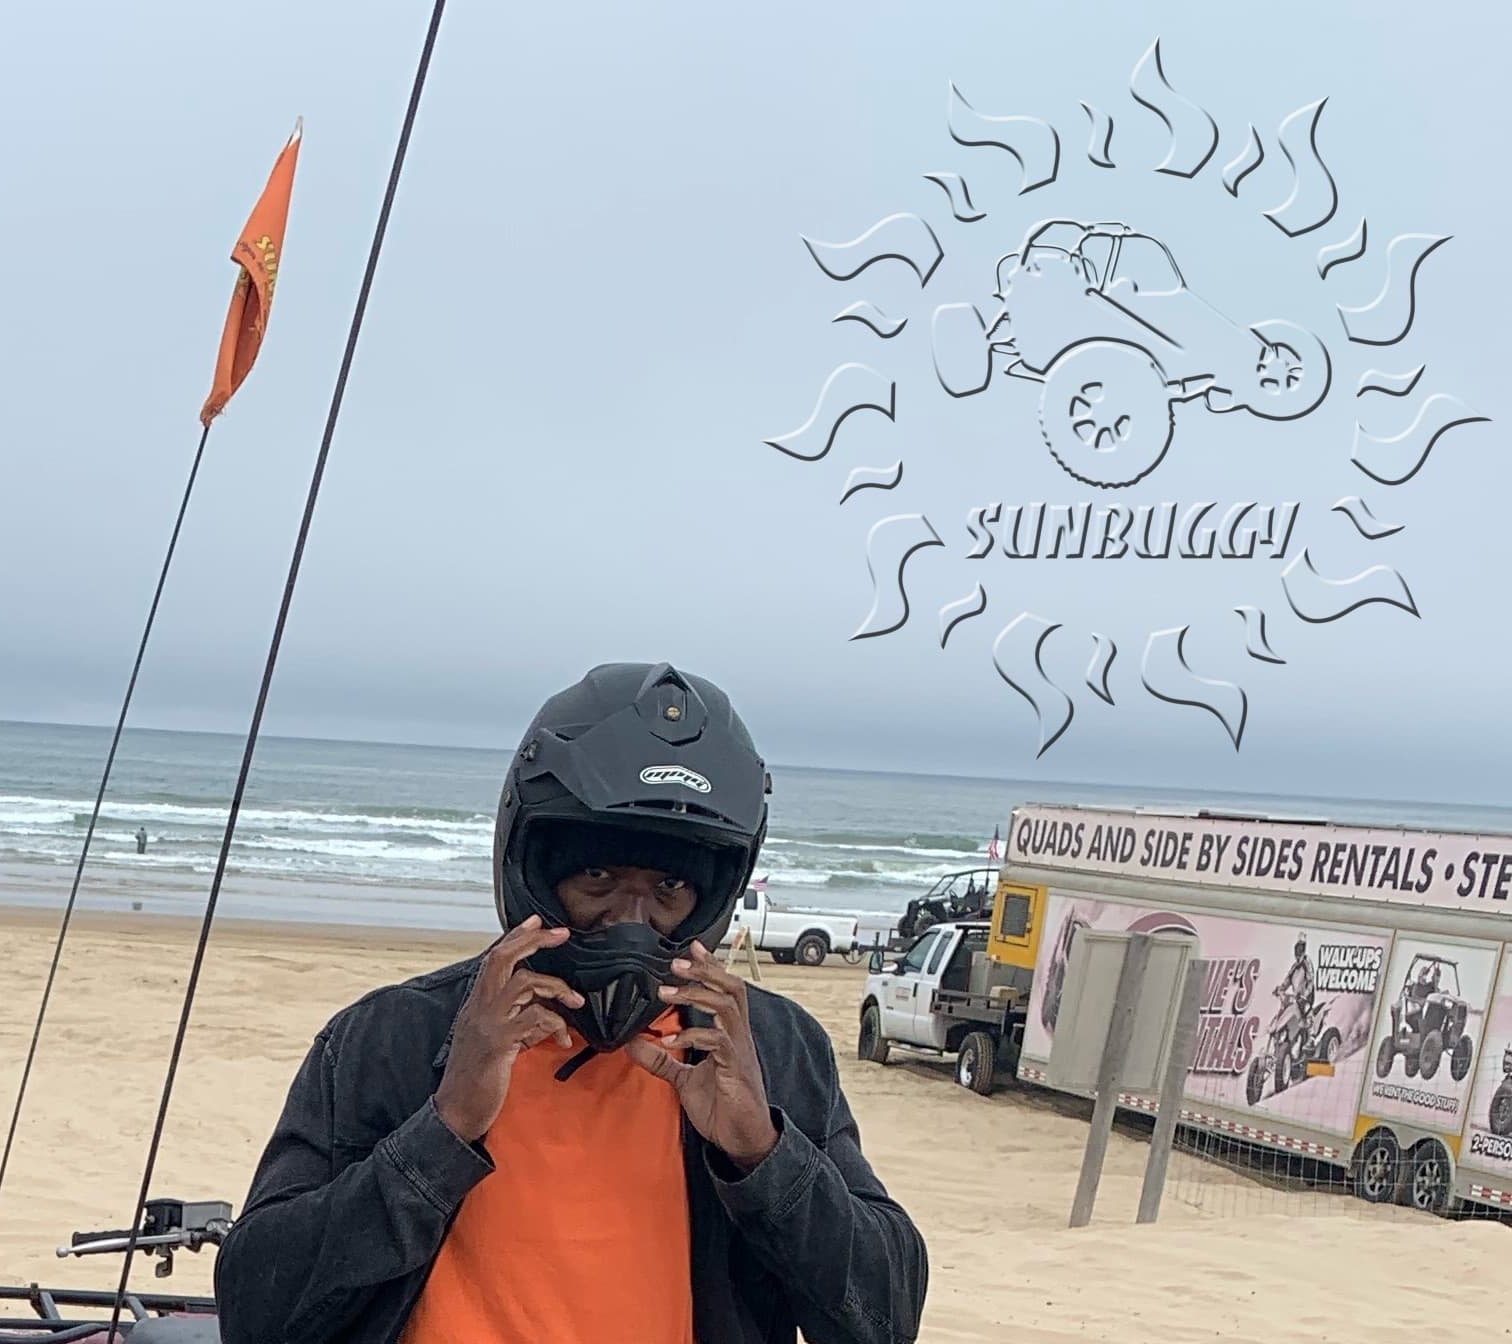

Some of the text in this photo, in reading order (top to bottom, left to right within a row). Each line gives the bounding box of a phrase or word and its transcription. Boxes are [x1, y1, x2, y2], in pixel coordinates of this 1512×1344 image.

[1017, 818, 1085, 860] QUADS
[1086, 824, 1137, 864] AND
[1140, 828, 1193, 870] SIDE
[1196, 834, 1232, 873] BY
[1231, 835, 1307, 881] SIDES
[1310, 841, 1438, 894] RENTALS
[1319, 945, 1383, 970] WALK-UPS
[1317, 967, 1378, 994] WELCOME
[1470, 1134, 1512, 1161] 2-PERSO
